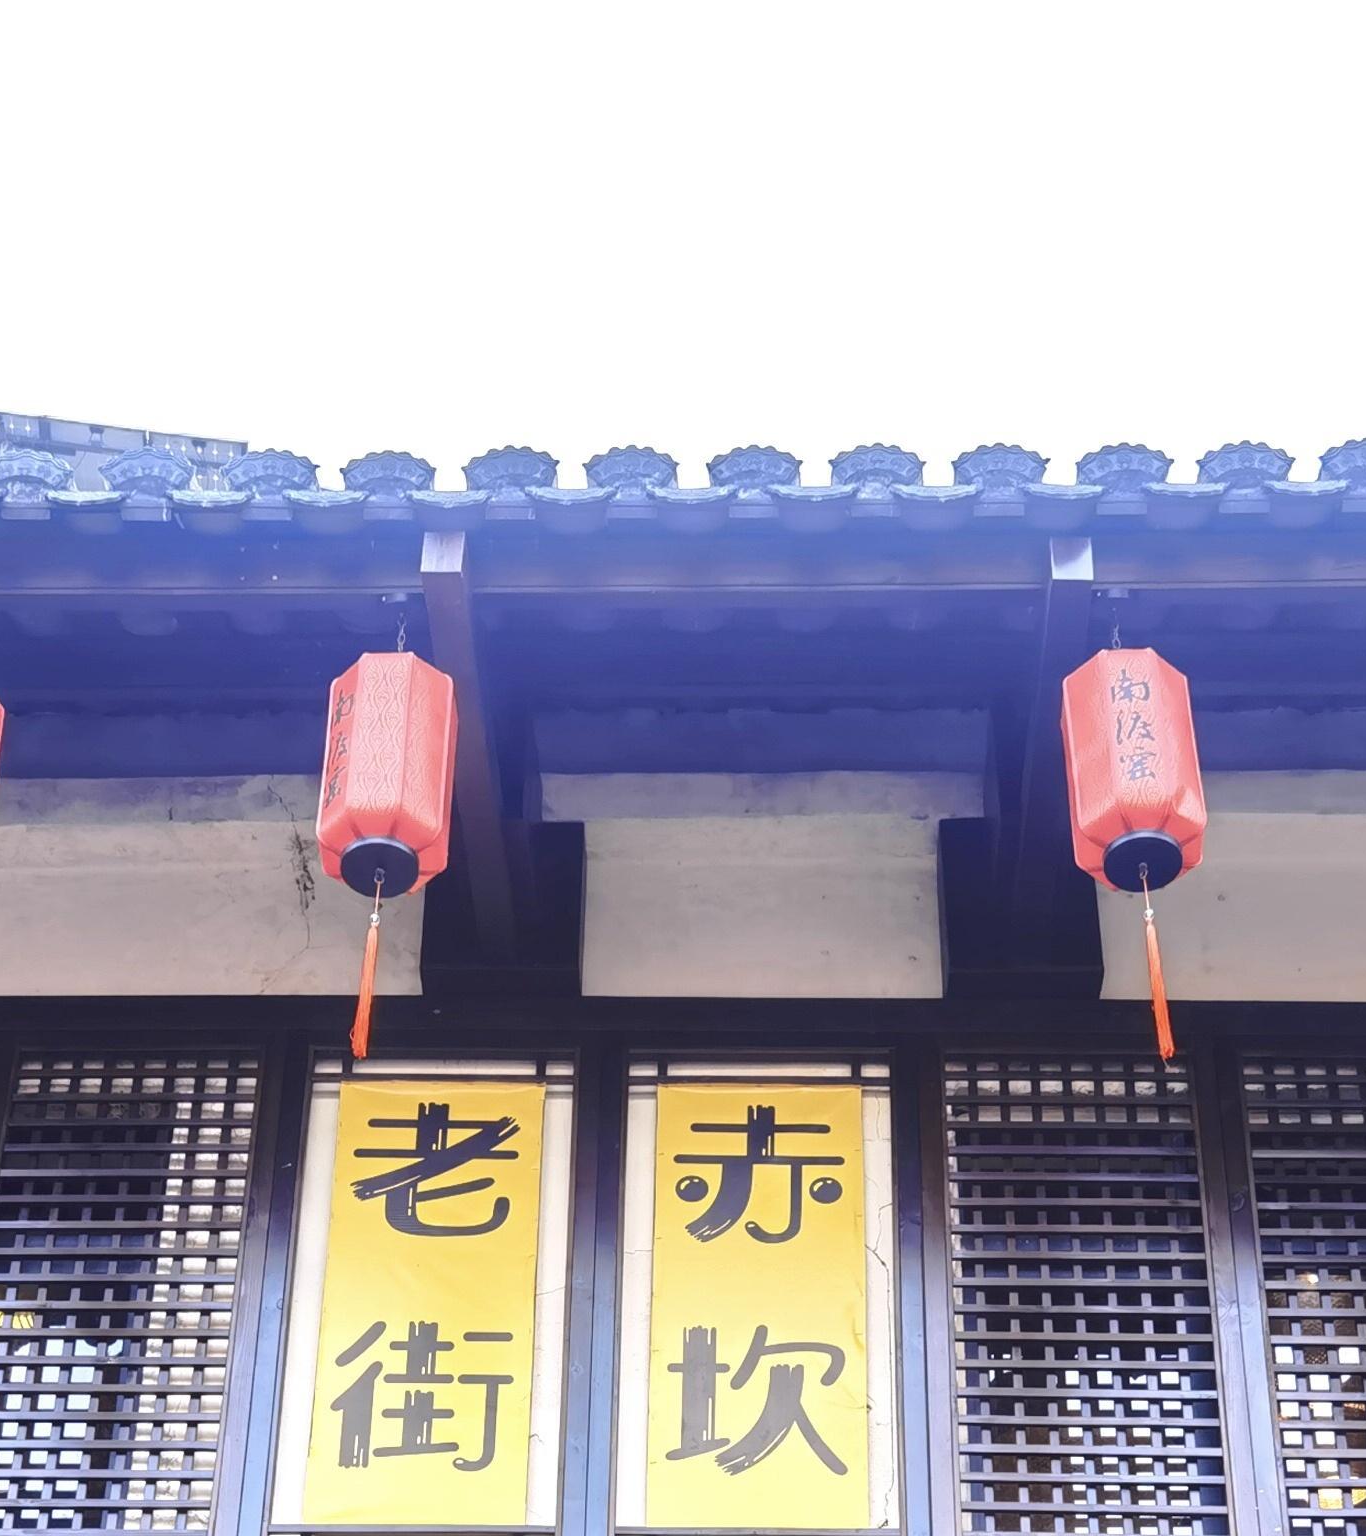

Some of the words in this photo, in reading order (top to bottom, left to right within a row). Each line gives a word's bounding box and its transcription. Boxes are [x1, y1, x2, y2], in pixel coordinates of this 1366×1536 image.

[1111, 668, 1157, 782] 南渡窑
[330, 1102, 521, 1472] 老街
[665, 1105, 848, 1476] 赤坎
